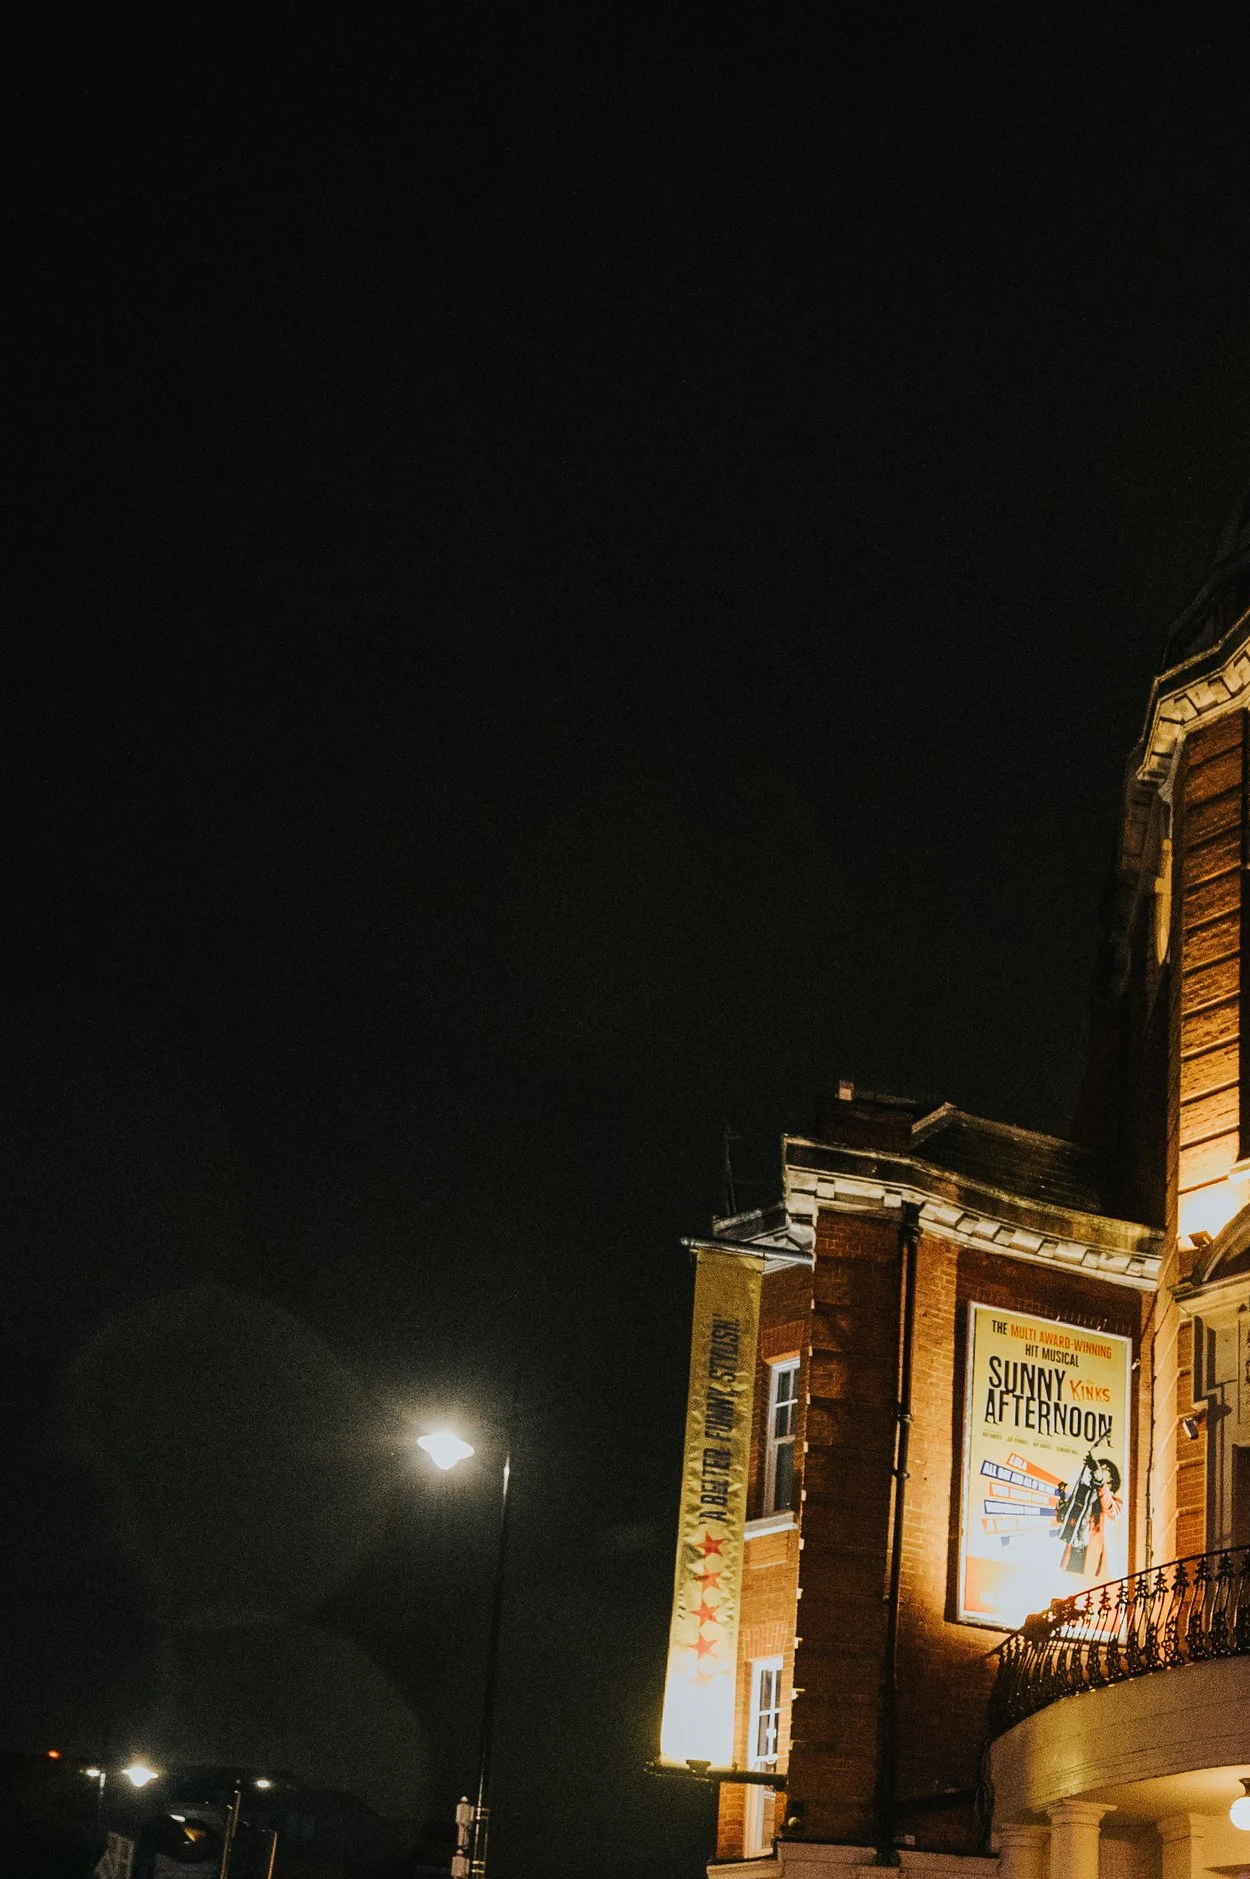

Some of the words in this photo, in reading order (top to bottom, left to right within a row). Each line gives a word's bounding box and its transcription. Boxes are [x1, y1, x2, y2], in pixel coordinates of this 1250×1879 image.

[992, 1320, 1008, 1335] THE
[1010, 1324, 1037, 1342] MULTI
[1039, 1331, 1112, 1360] AWARD-WINNING
[1025, 1343, 1039, 1359] HIT
[1041, 1347, 1080, 1368] MUSICAL
[988, 1355, 1066, 1402] SUNNY
[1069, 1379, 1111, 1402] KINKS
[984, 1387, 1114, 1448] AFTERNOON
